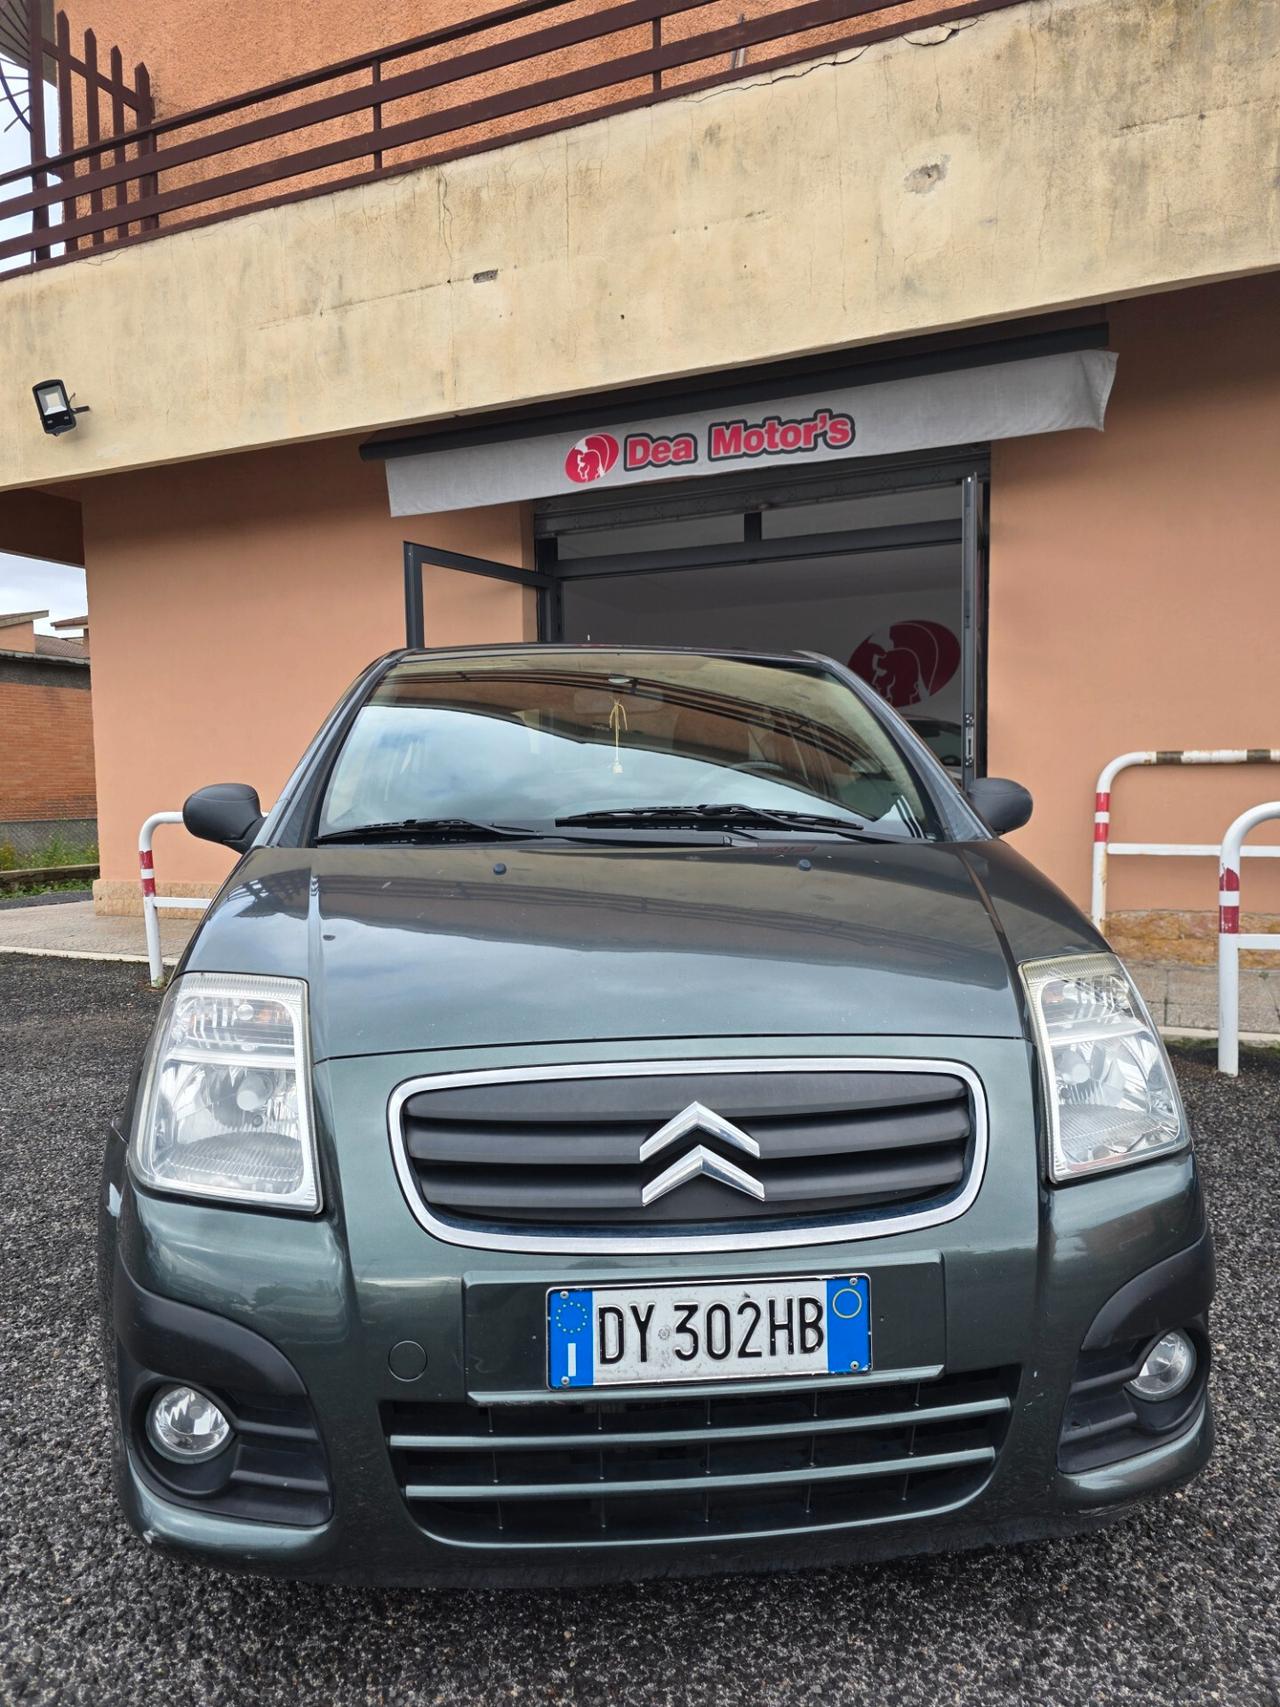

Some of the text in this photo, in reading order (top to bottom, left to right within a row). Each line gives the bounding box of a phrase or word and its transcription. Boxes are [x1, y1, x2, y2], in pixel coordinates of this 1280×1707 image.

[625, 409, 854, 471] Dea Motor's
[567, 1343, 577, 1377] I
